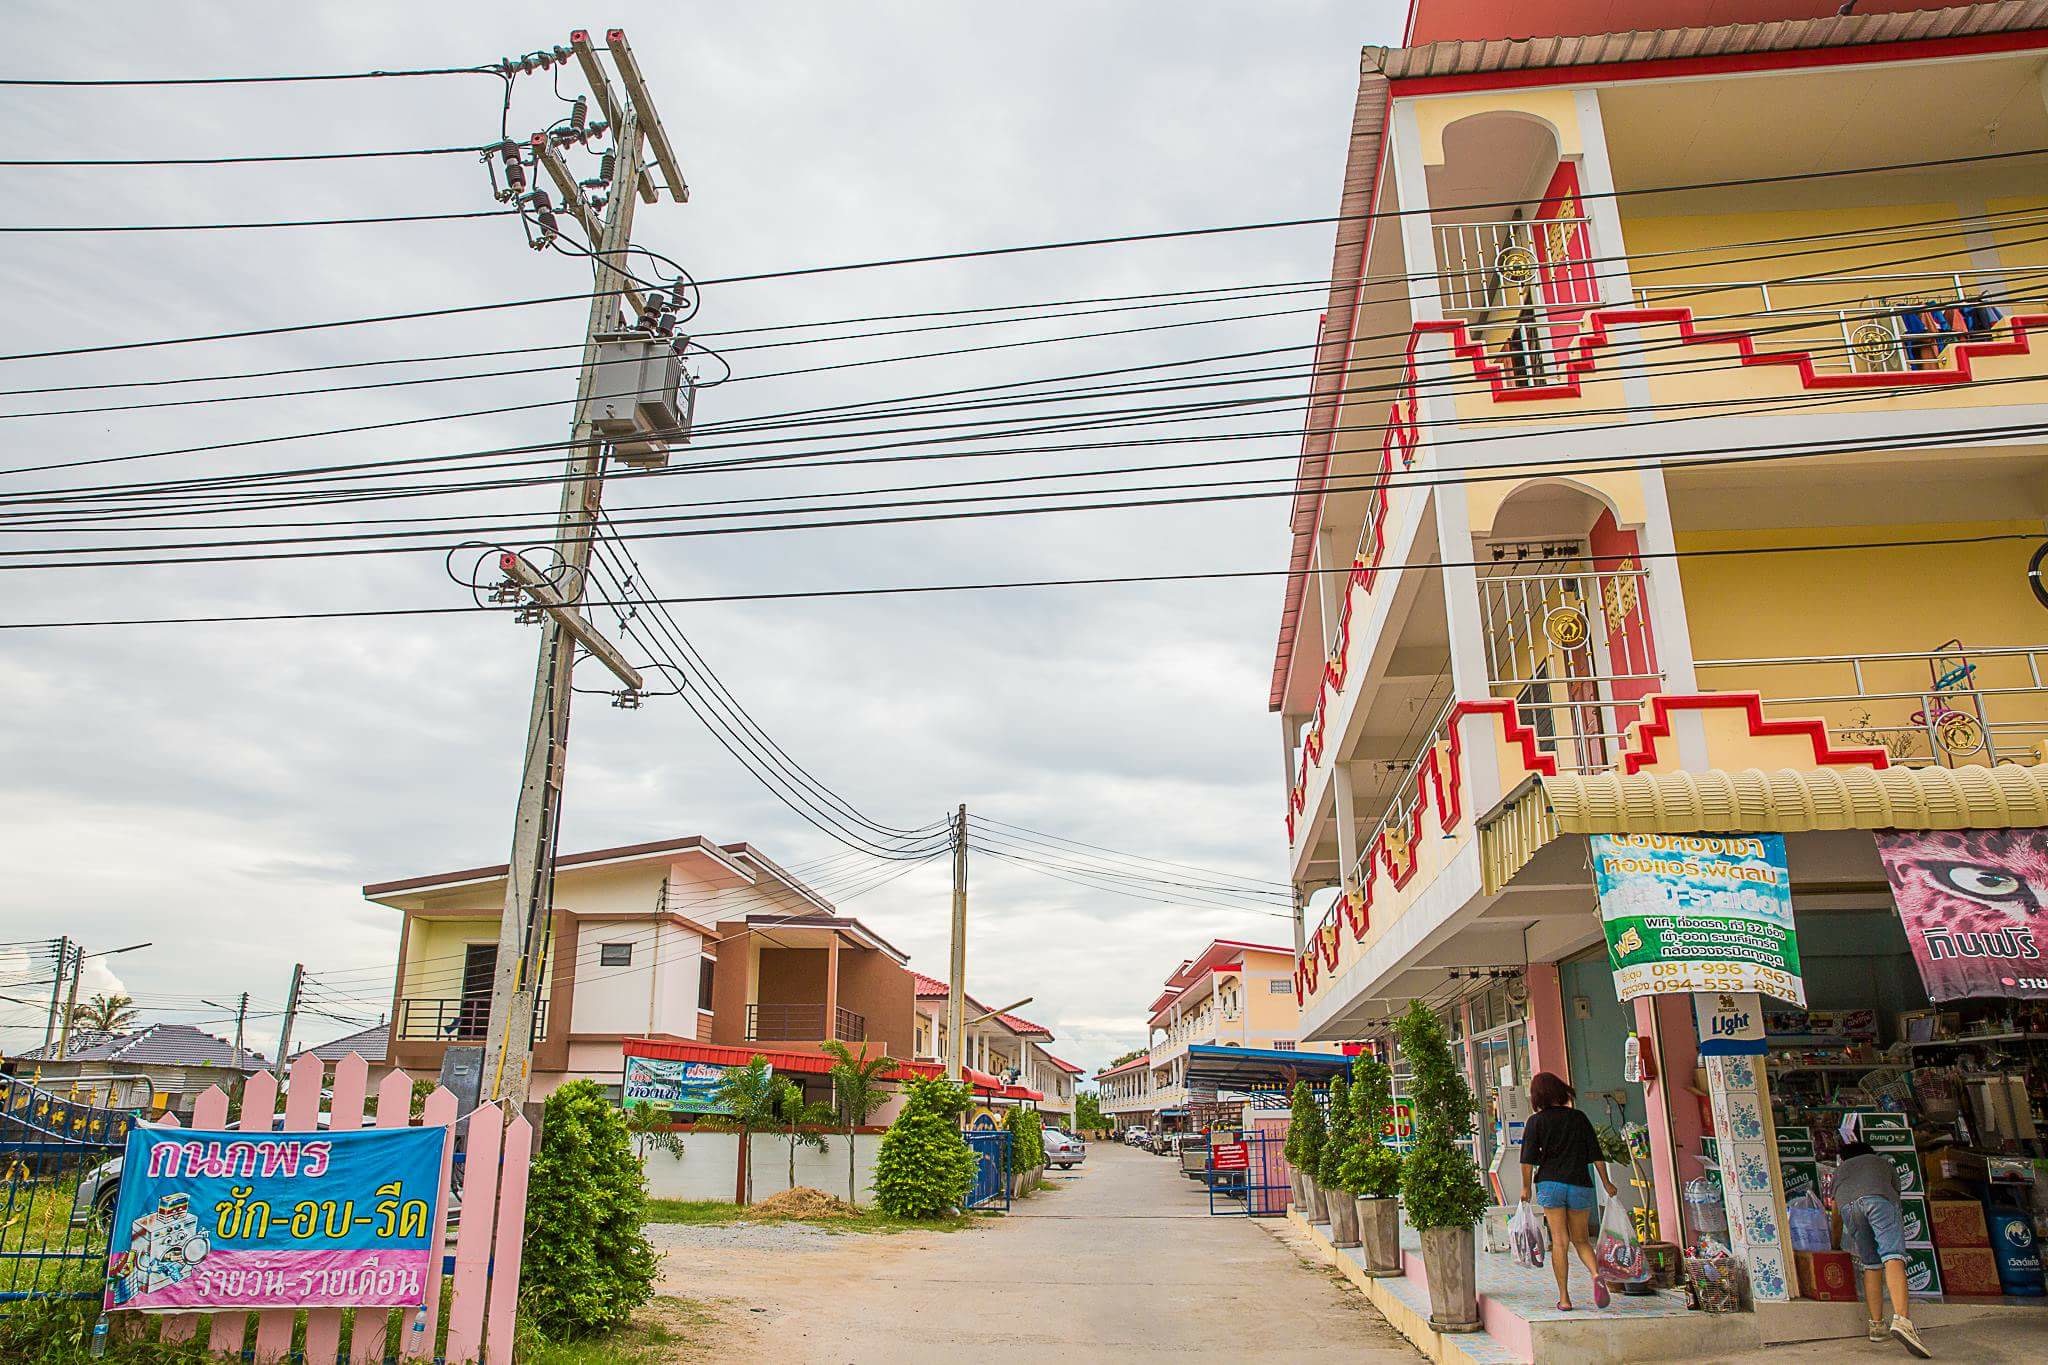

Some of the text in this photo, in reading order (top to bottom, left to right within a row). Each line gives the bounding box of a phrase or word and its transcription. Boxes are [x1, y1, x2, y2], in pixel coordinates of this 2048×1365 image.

[1613, 926, 1643, 958] ฟรี
[1747, 923, 1763, 934] 32
[1922, 927, 2040, 960] กินฟรี
[1651, 963, 1744, 977] 081-996
[1751, 965, 1794, 986] 7861
[1653, 978, 1745, 993] 094-553
[1753, 979, 1798, 1001] 8878
[147, 1140, 332, 1178] กนกพร
[1784, 1172, 1810, 1189] hang
[214, 1180, 430, 1240] ซัก-อบ-รีด
[198, 1256, 421, 1298] รายวัน-รายเดือน
